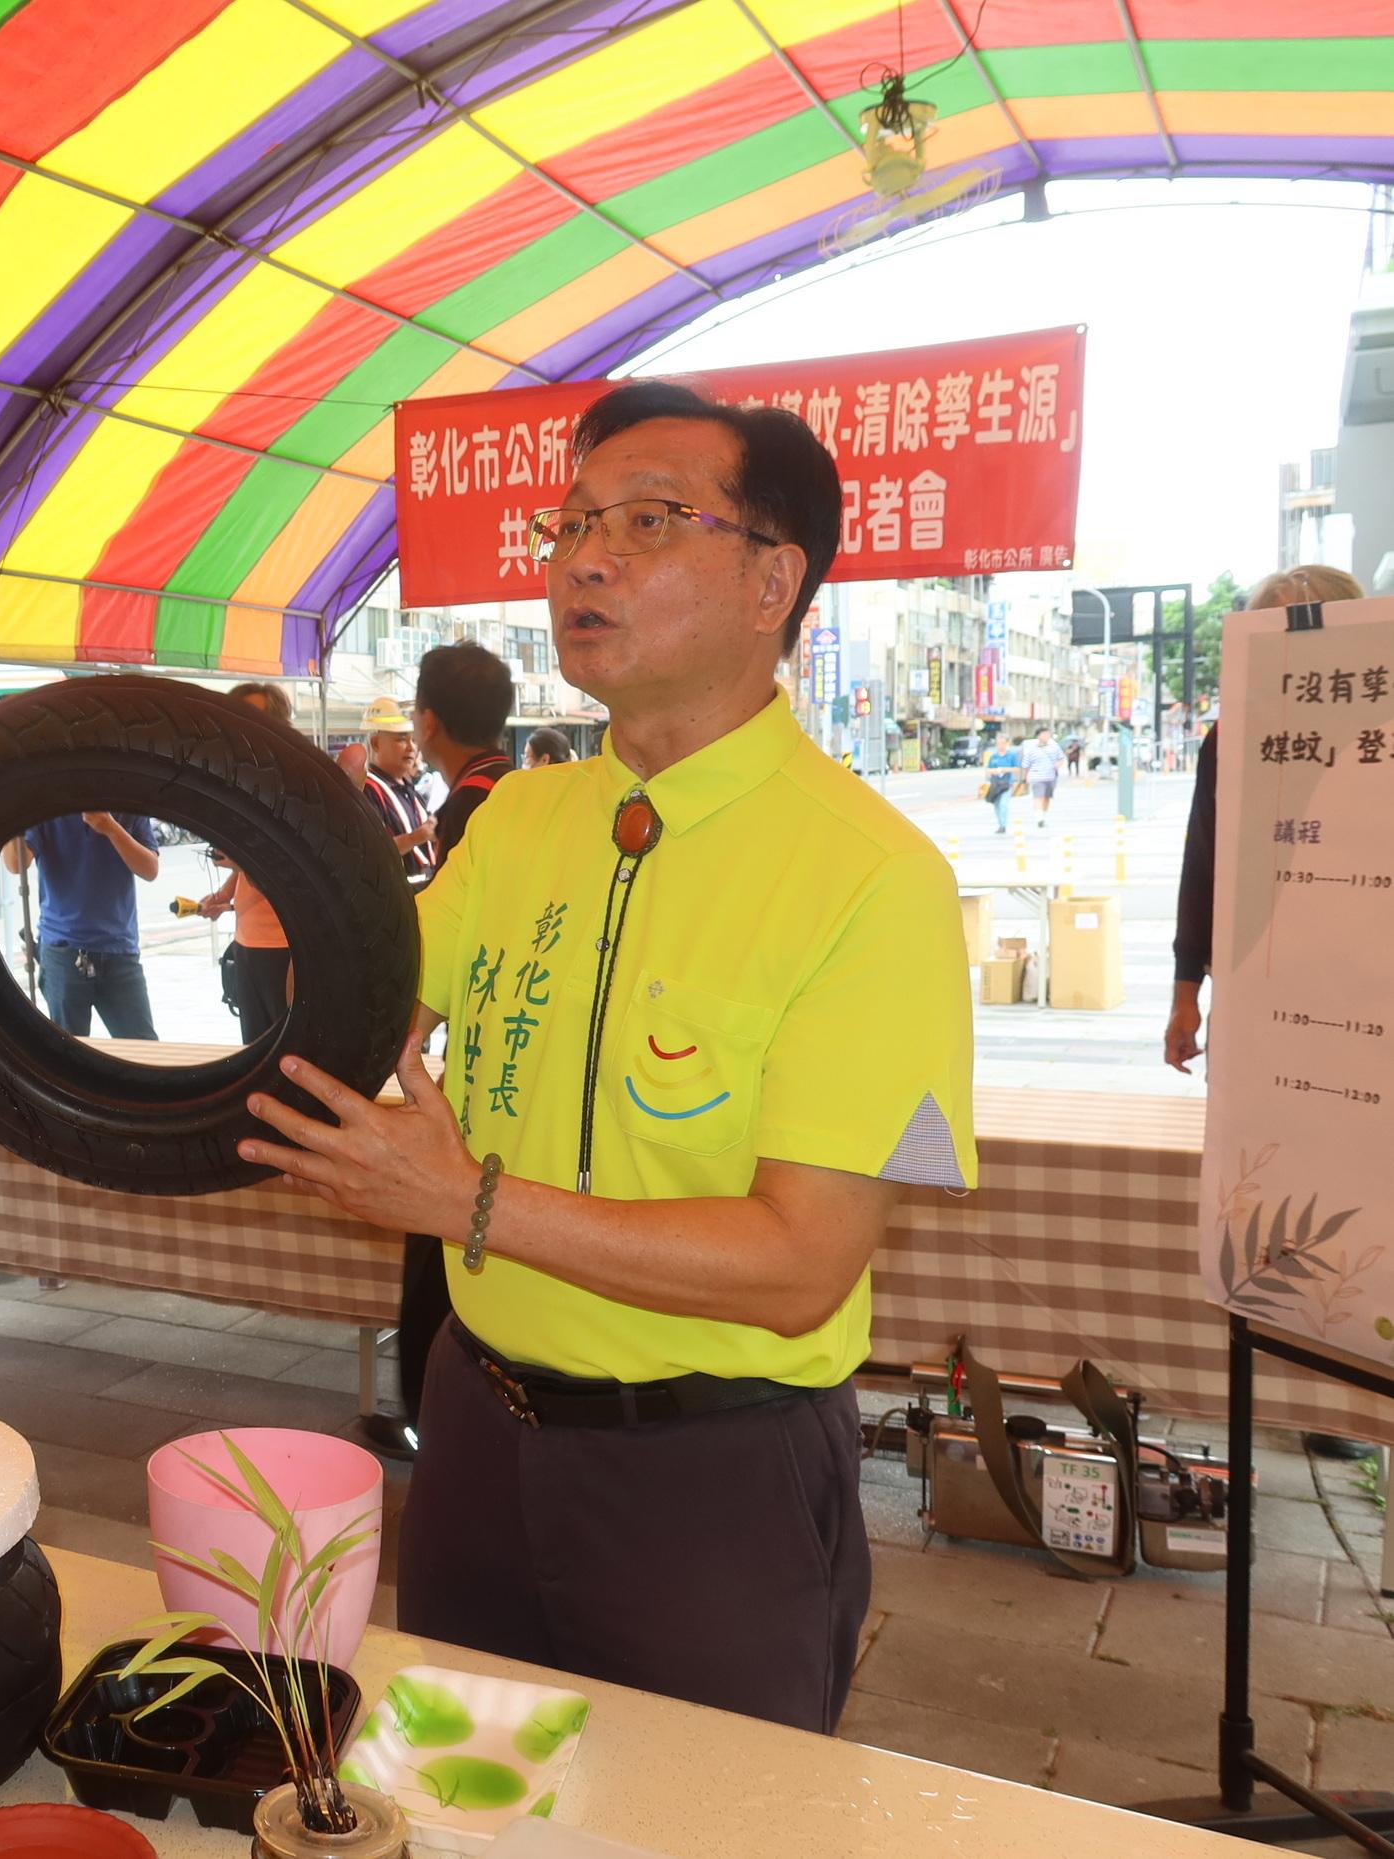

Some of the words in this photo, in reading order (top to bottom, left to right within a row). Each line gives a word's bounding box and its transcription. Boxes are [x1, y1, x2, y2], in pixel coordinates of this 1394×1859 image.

[409, 413, 583, 501] 彰化市公所
[963, 548, 1033, 570] 彰化市公所
[1260, 730, 1336, 768] 媒蚊」
[1357, 728, 1394, 765] 登
[1273, 818, 1321, 845] 議程
[488, 900, 568, 1117] 彰化市長
[1060, 1462, 1078, 1475] TF
[1082, 1465, 1101, 1479] 35
